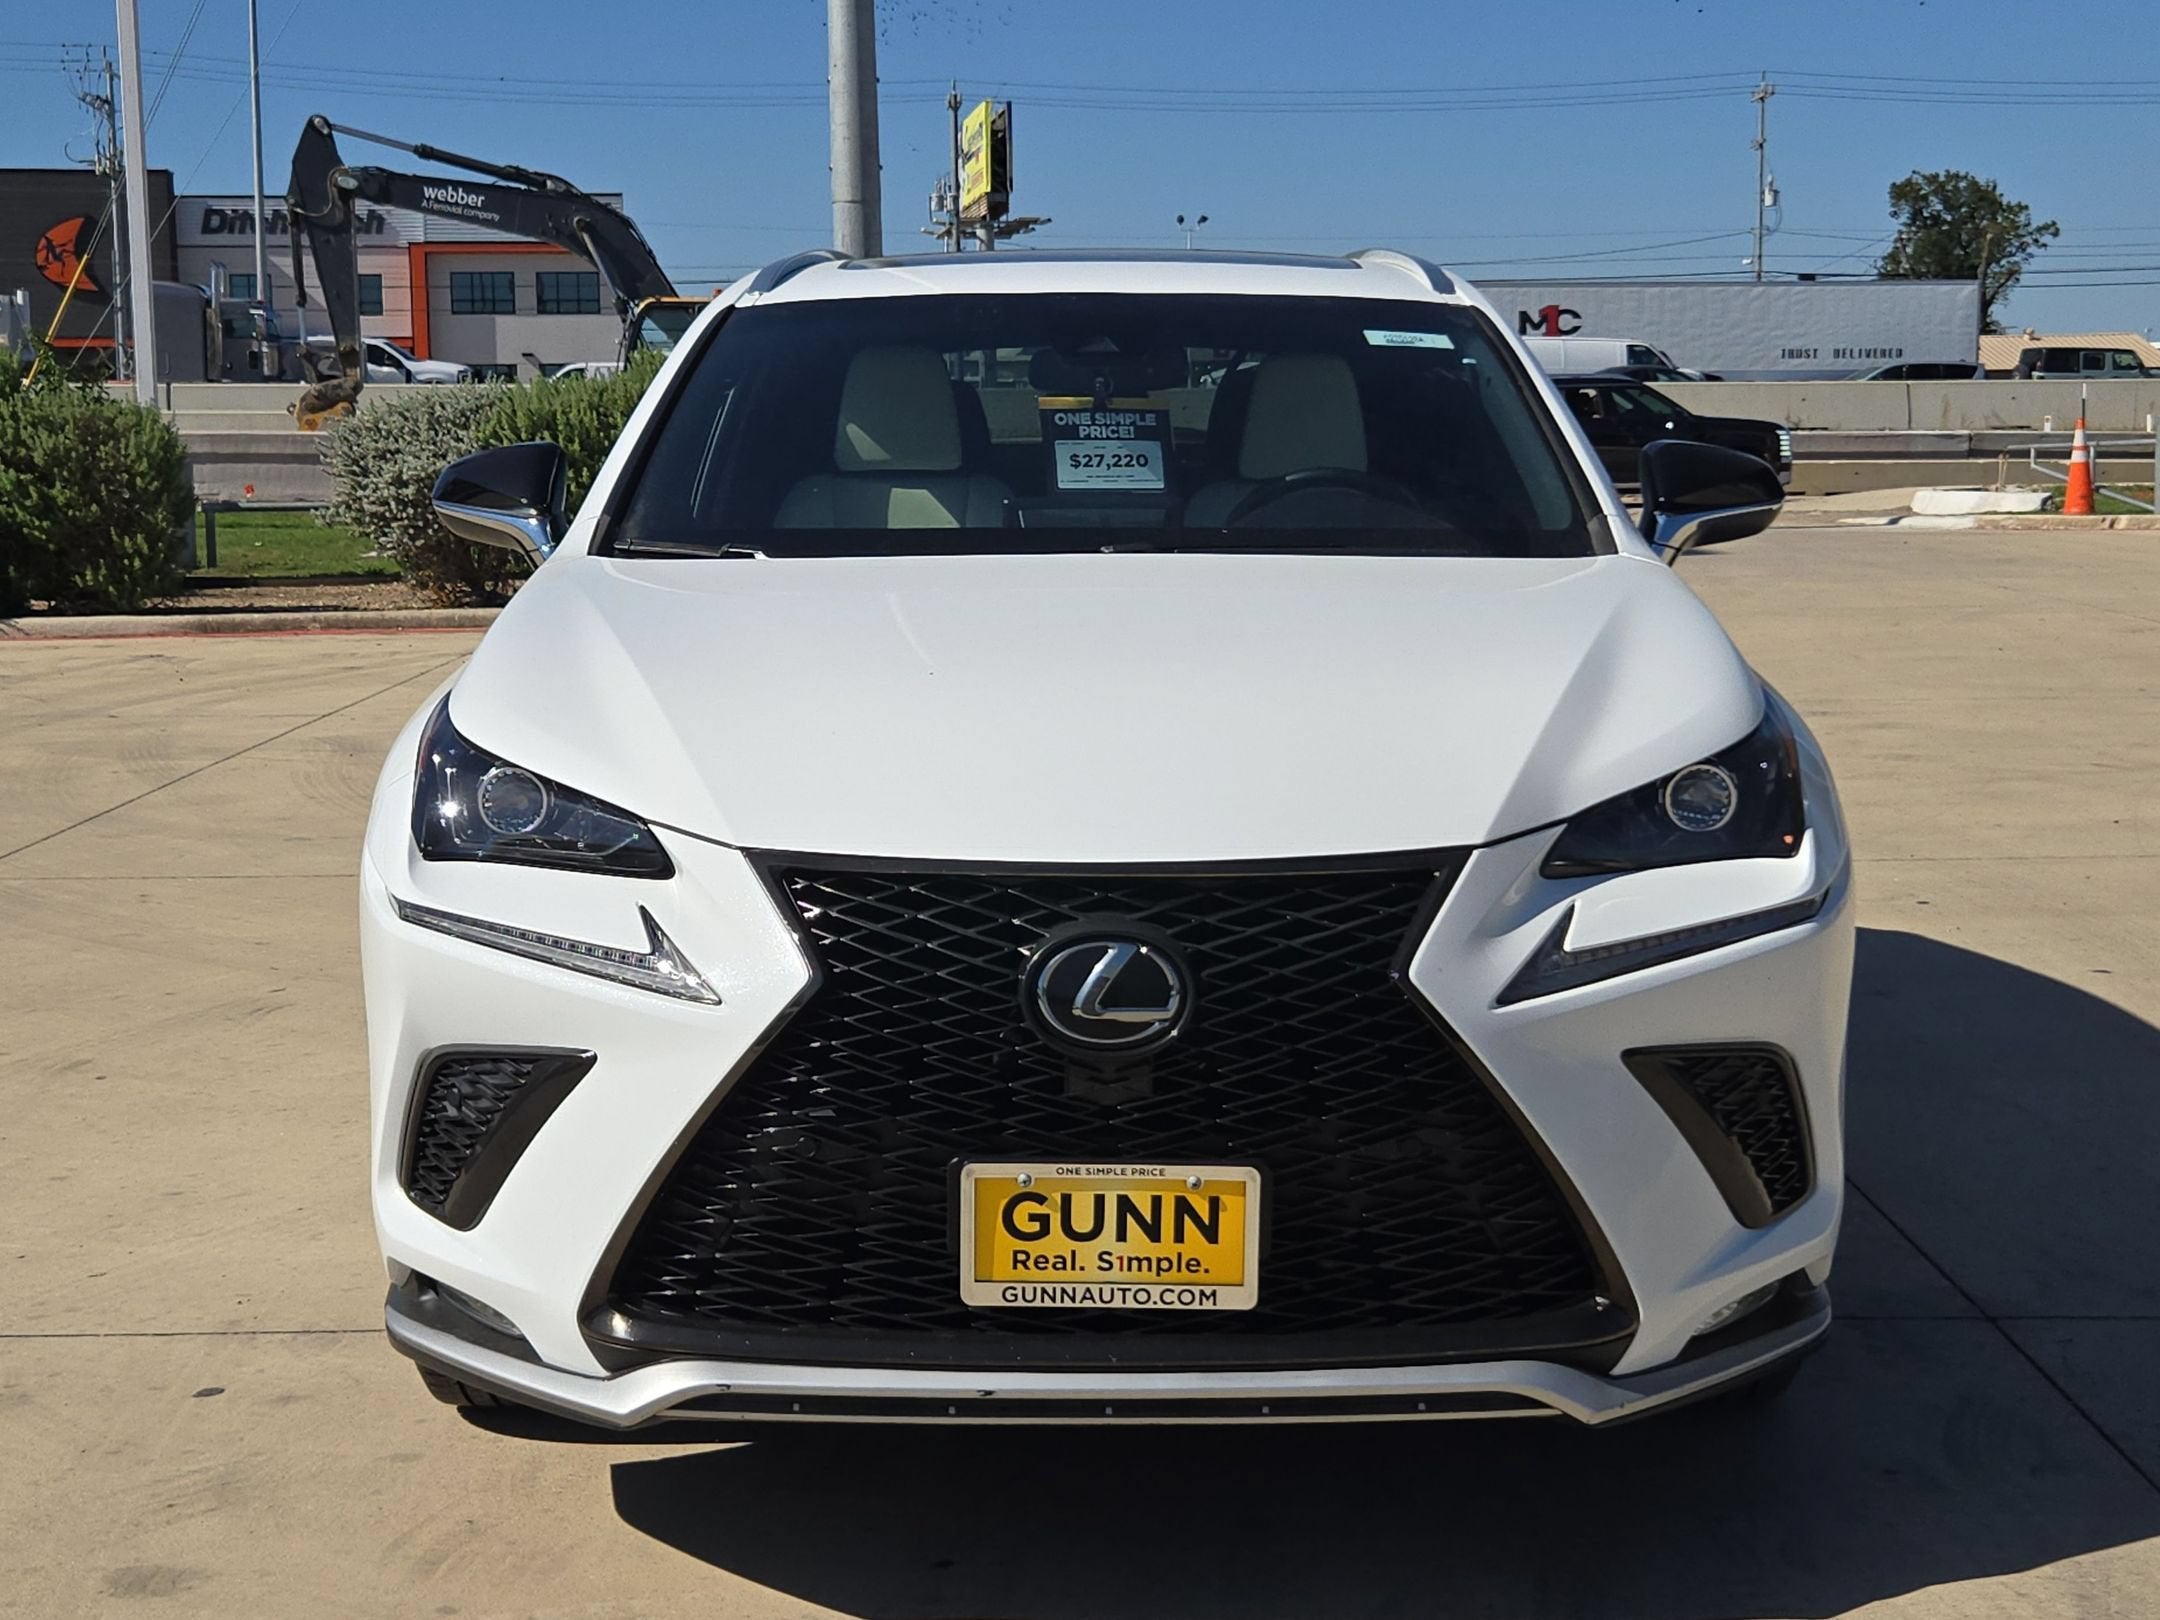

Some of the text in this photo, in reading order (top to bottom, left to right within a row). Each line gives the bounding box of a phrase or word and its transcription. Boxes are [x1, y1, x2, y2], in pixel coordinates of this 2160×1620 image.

[423, 185, 485, 207] webber
[463, 207, 500, 222] company
[1780, 347, 1904, 360] TRUST DELIVERED
[1054, 412, 1157, 426] ONE SIMPLE
[1078, 425, 1135, 439] PRICE!
[1069, 453, 1149, 471] $27,220
[1056, 1166, 1166, 1177] ONE SIMPLE PRICE
[1001, 1191, 1221, 1245] GUNN
[1012, 1249, 1086, 1272] Real.
[1001, 1286, 1218, 1307] GUNNAUTO.COM
